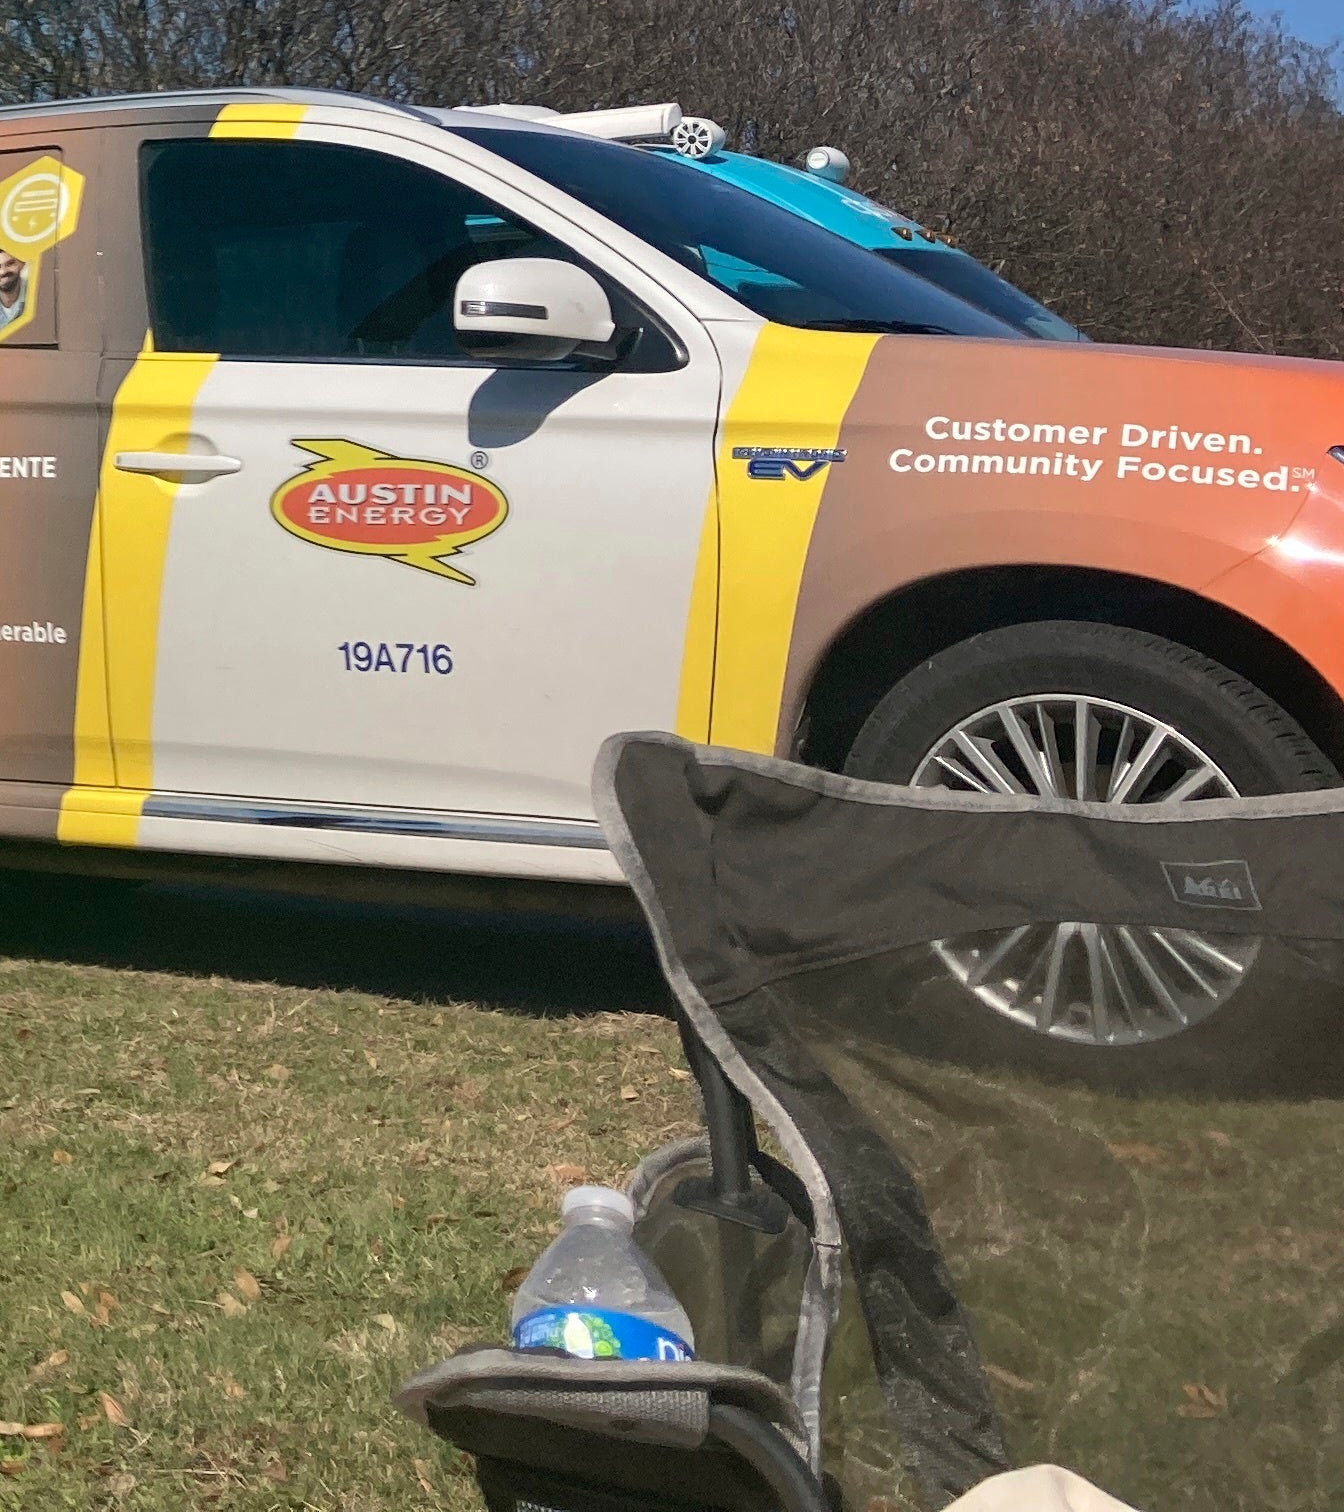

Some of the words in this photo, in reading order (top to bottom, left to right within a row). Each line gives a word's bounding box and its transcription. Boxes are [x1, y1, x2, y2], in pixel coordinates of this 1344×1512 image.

[924, 416, 1108, 446] Customer
[1120, 423, 1263, 455] Driven.
[747, 457, 829, 481] EV
[888, 448, 1104, 482] Community
[1116, 455, 1300, 493] Focused.
[308, 483, 472, 505] AUSTIN
[307, 506, 471, 525] ENERGY
[338, 641, 454, 675] 19A716
